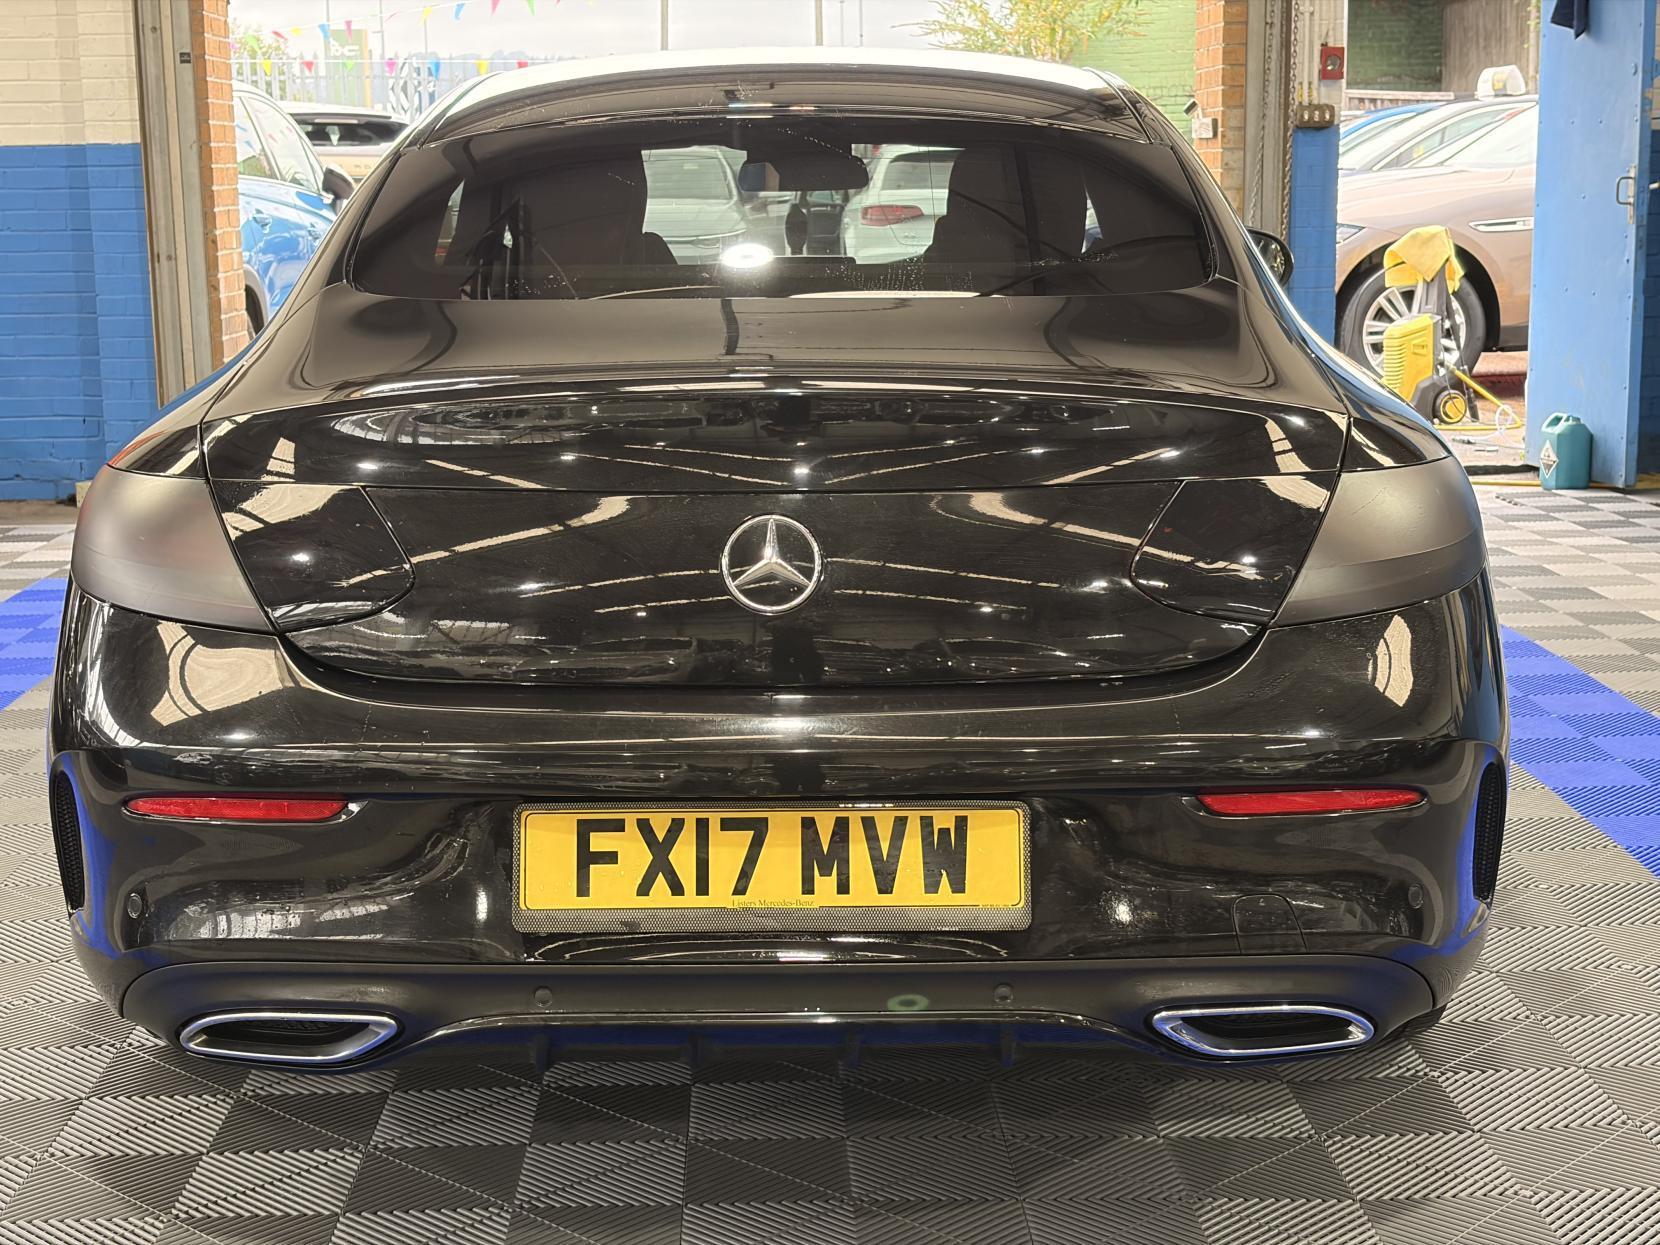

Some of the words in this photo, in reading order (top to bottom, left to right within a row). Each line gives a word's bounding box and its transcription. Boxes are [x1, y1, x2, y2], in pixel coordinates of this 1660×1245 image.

[576, 817, 769, 897] FX17
[800, 816, 969, 895] MVW
[731, 899, 757, 907] Listers
[759, 899, 815, 907] Mercedes-Benz
